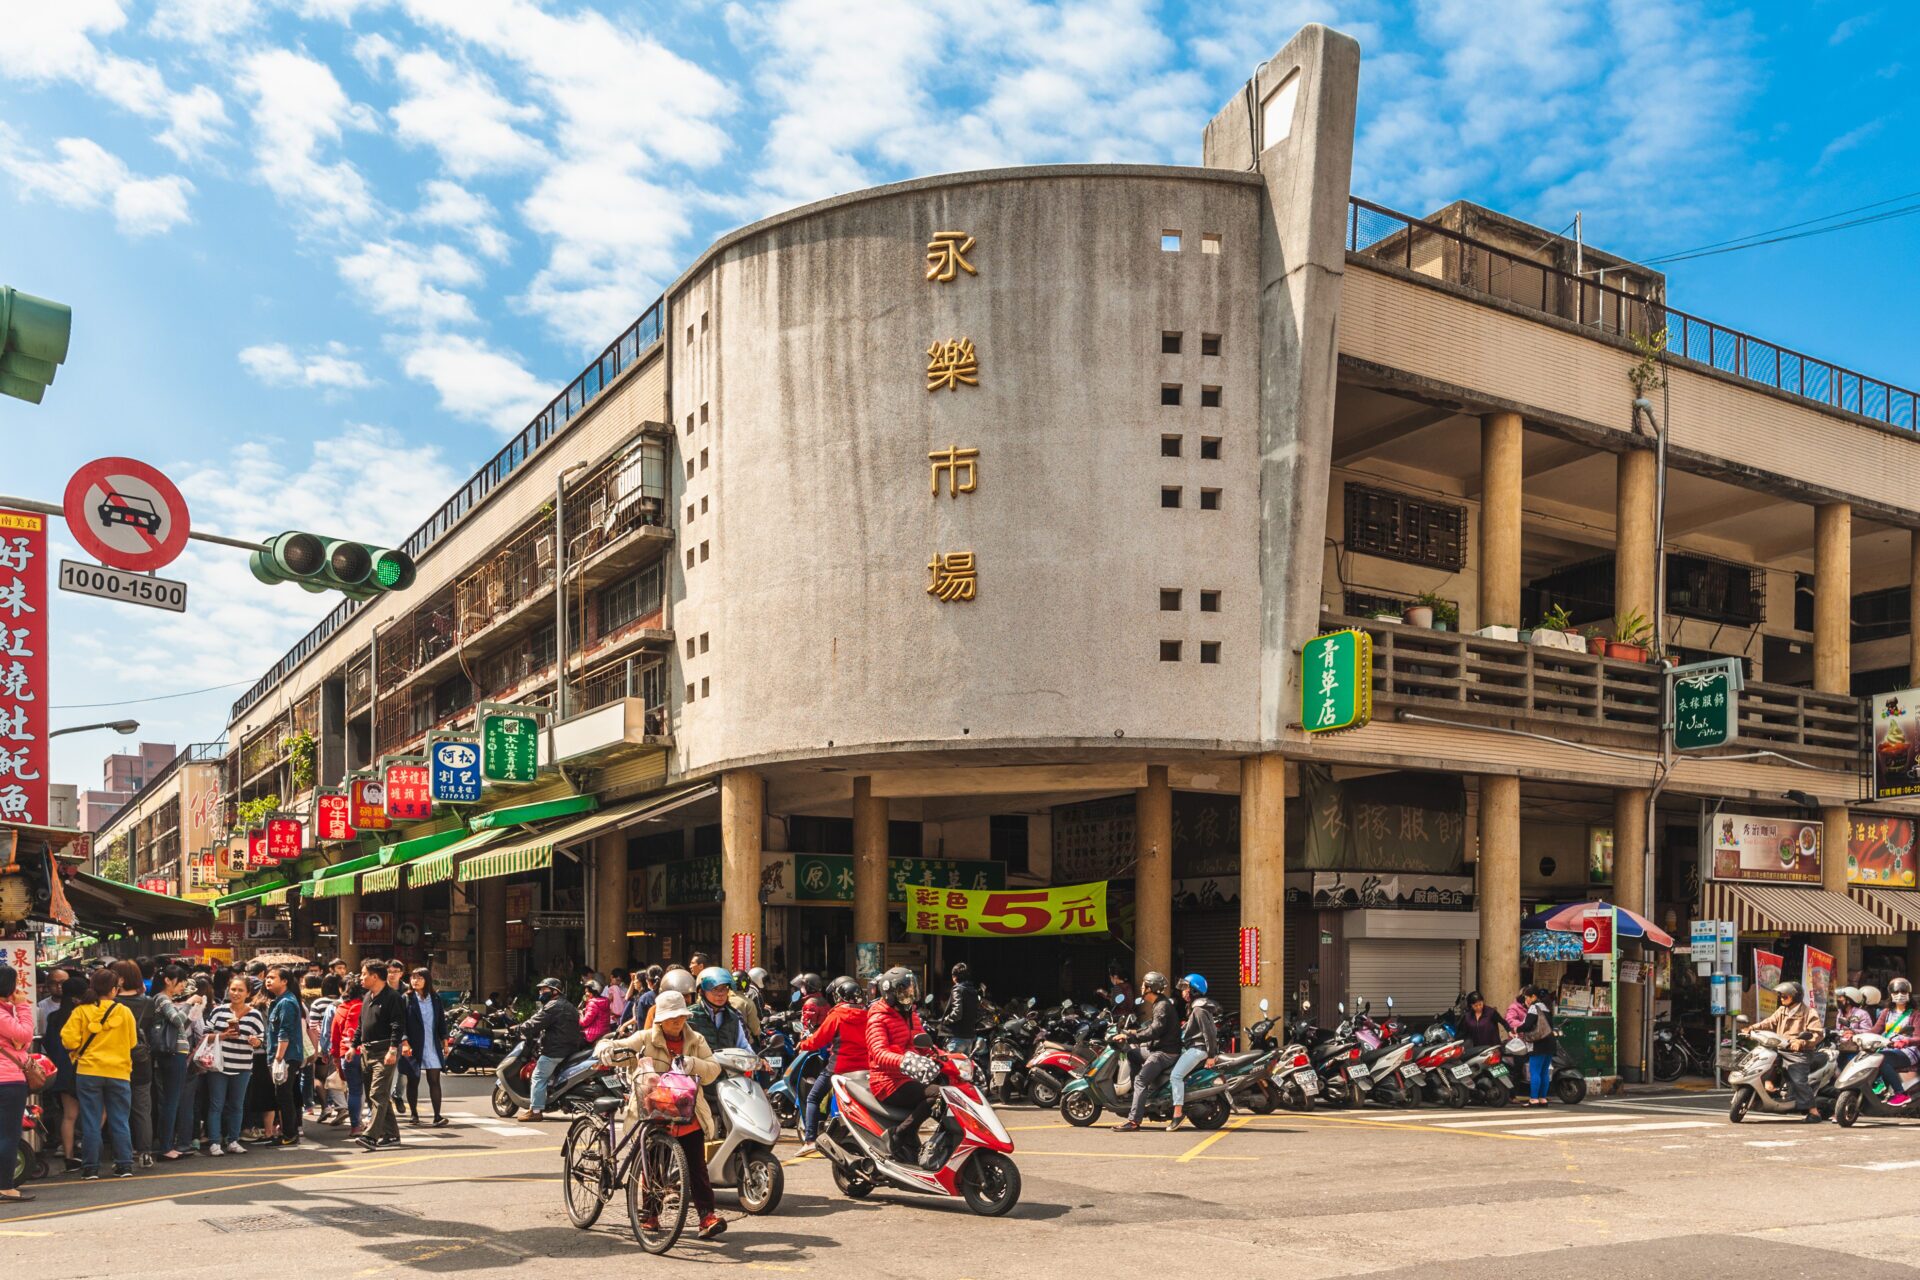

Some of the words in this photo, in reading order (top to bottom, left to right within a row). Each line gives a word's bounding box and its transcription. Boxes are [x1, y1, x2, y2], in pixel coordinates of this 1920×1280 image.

[926, 231, 981, 601] 永樂市場
[64, 566, 183, 606] 1000-1500
[1316, 639, 1340, 726] 青草店
[441, 749, 473, 764] 阿松
[438, 769, 476, 785] 割包
[329, 809, 346, 839] 牛肉湯
[915, 888, 969, 910] 彩色
[916, 911, 969, 933] 影印
